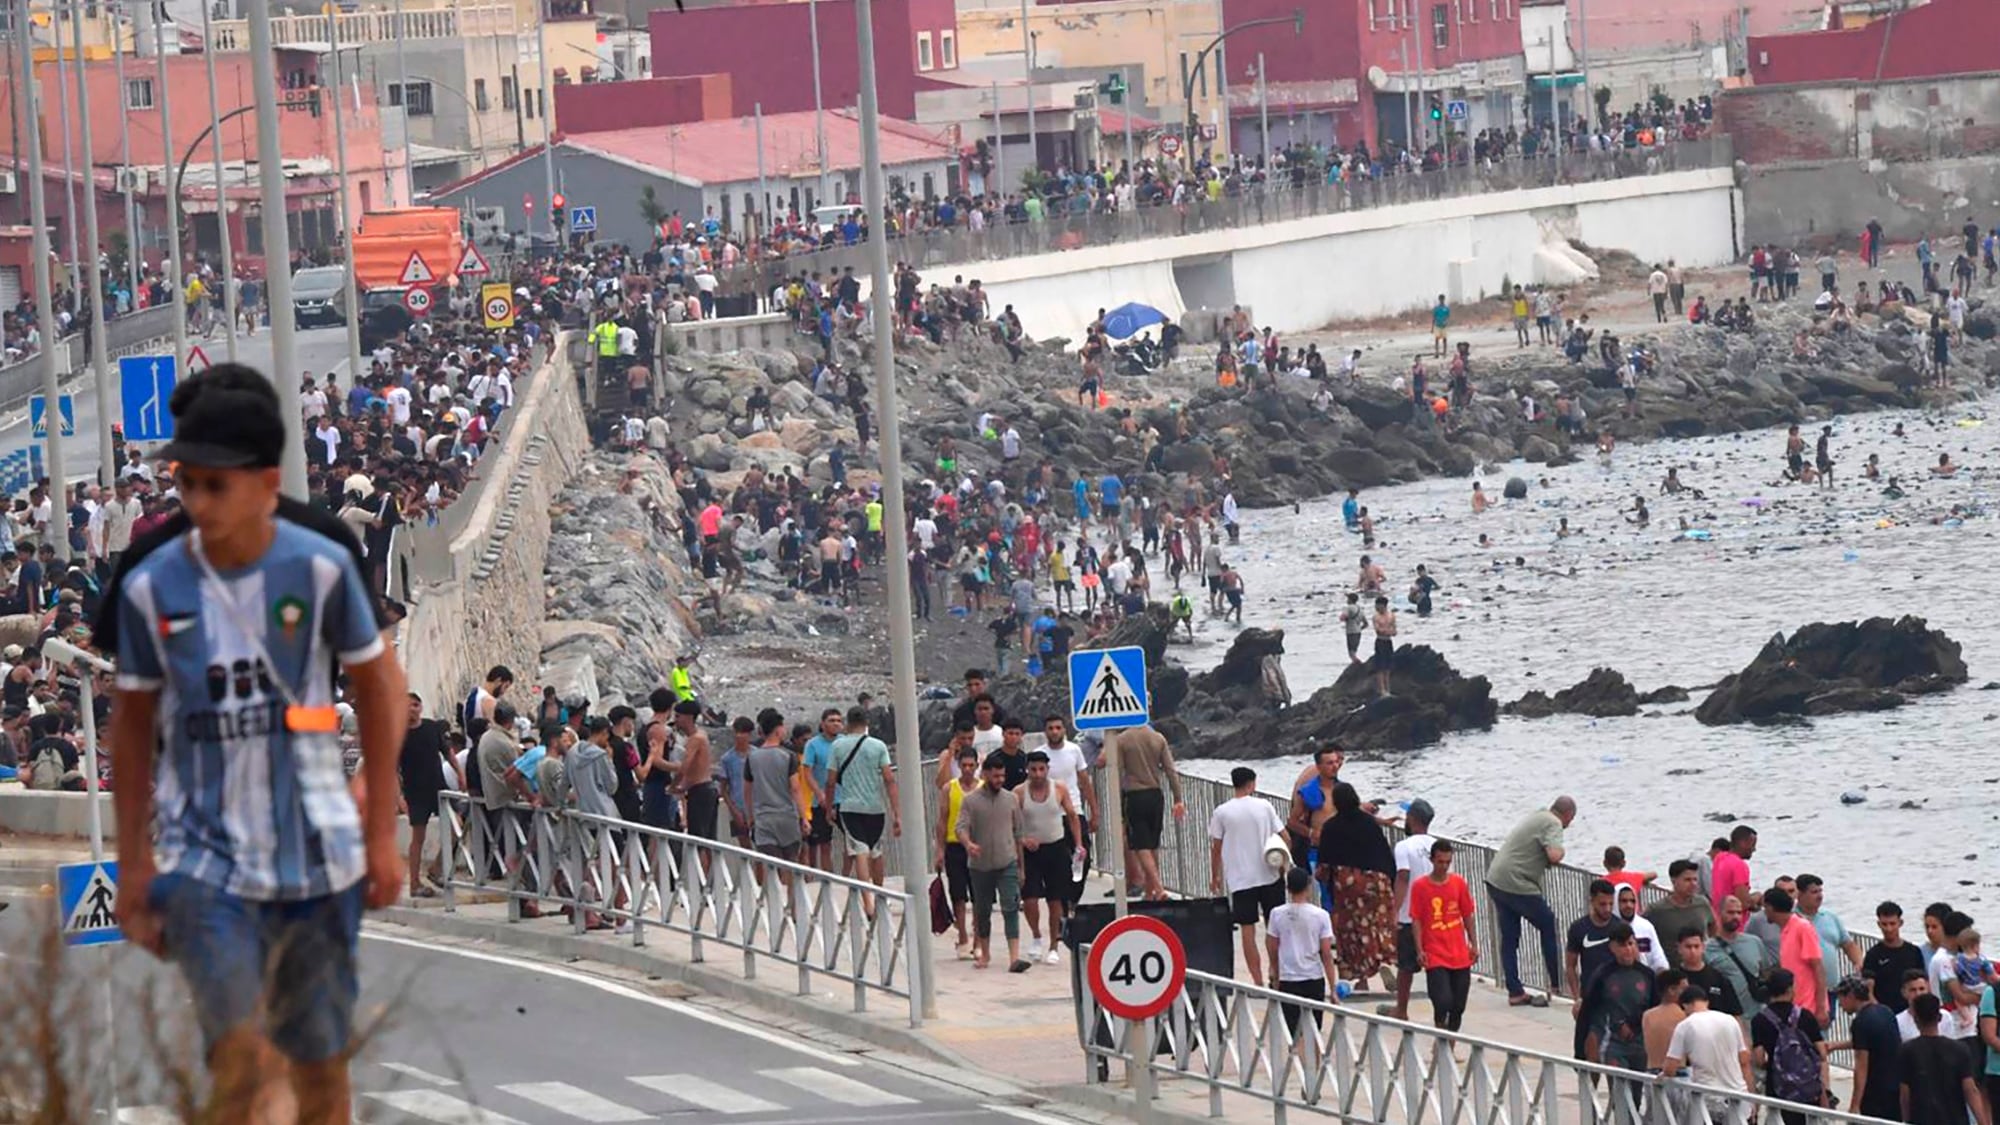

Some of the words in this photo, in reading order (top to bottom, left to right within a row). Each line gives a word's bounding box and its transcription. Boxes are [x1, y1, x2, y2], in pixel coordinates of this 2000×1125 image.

[410, 294, 427, 305] 30
[490, 303, 506, 314] 30
[1108, 950, 1165, 986] 40
